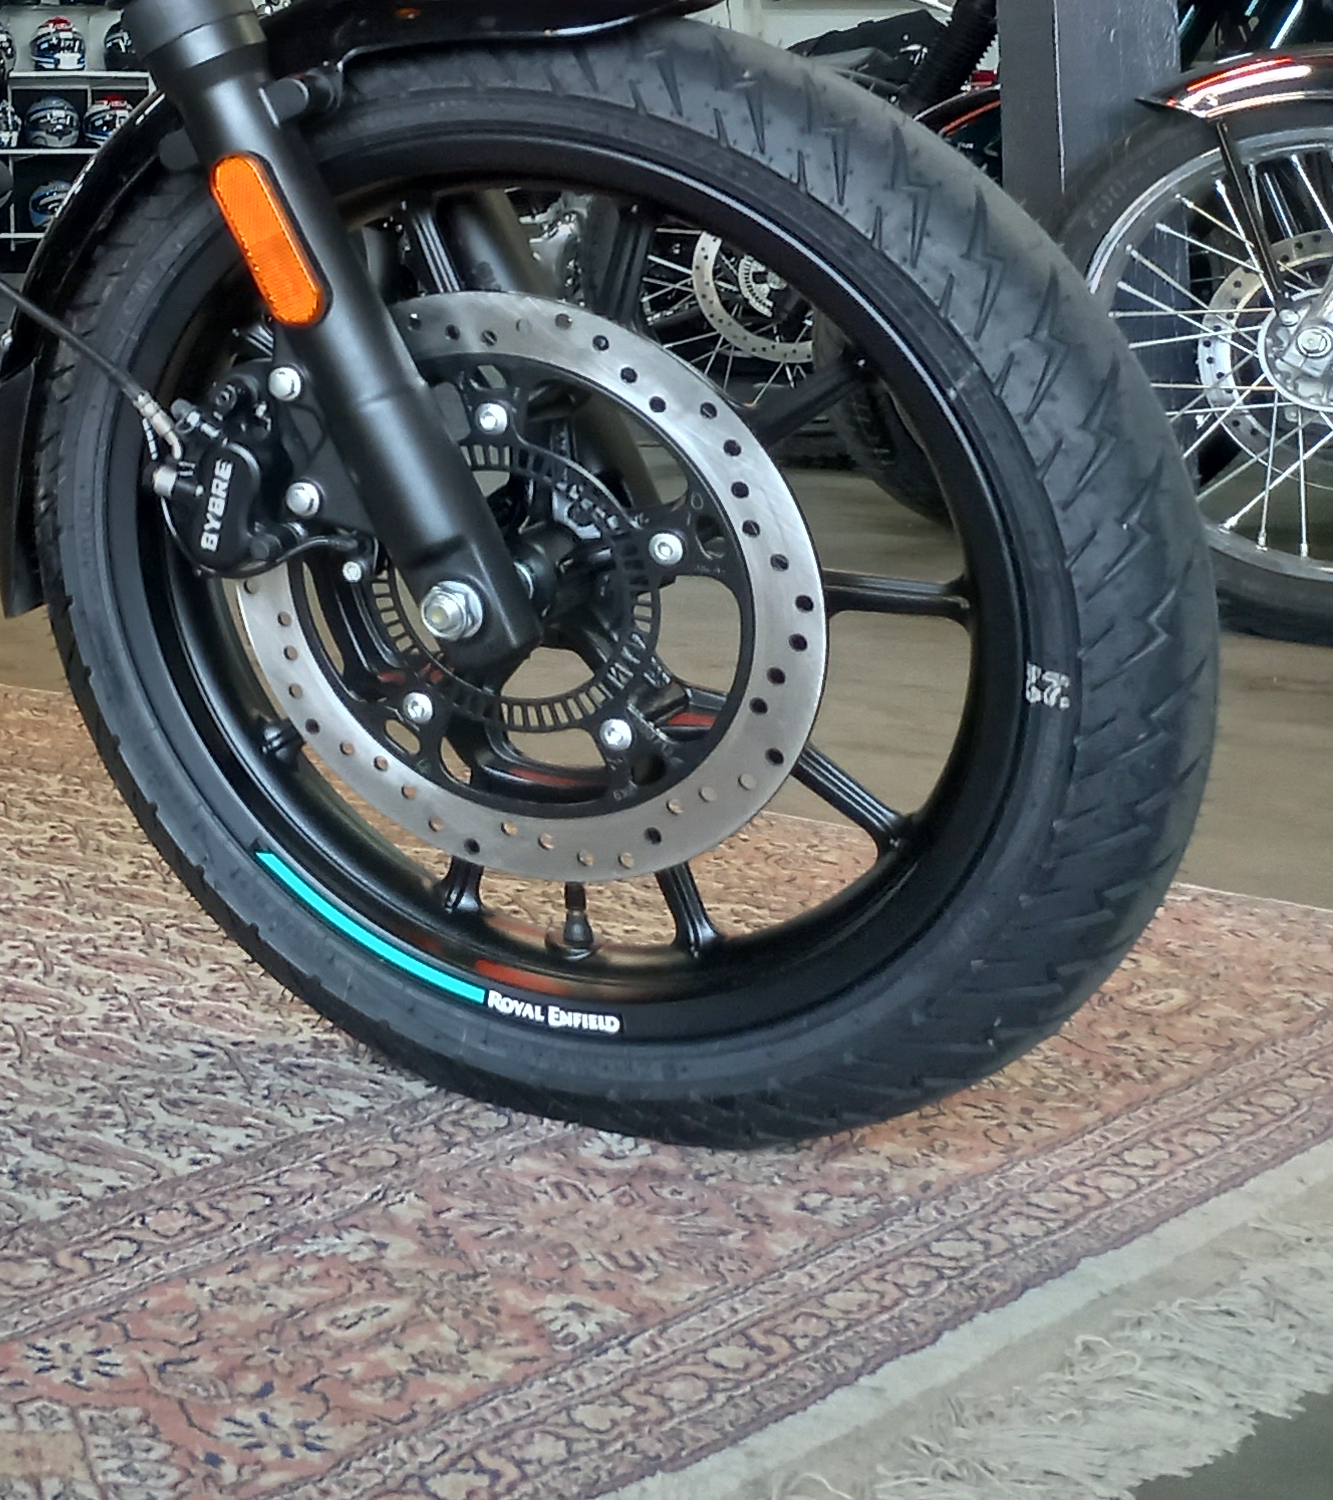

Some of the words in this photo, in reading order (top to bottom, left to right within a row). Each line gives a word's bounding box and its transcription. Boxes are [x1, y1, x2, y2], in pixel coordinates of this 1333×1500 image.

[200, 458, 233, 553] BYBRE
[488, 990, 544, 1022] ROYAL
[548, 1005, 621, 1034] ENFIELD
